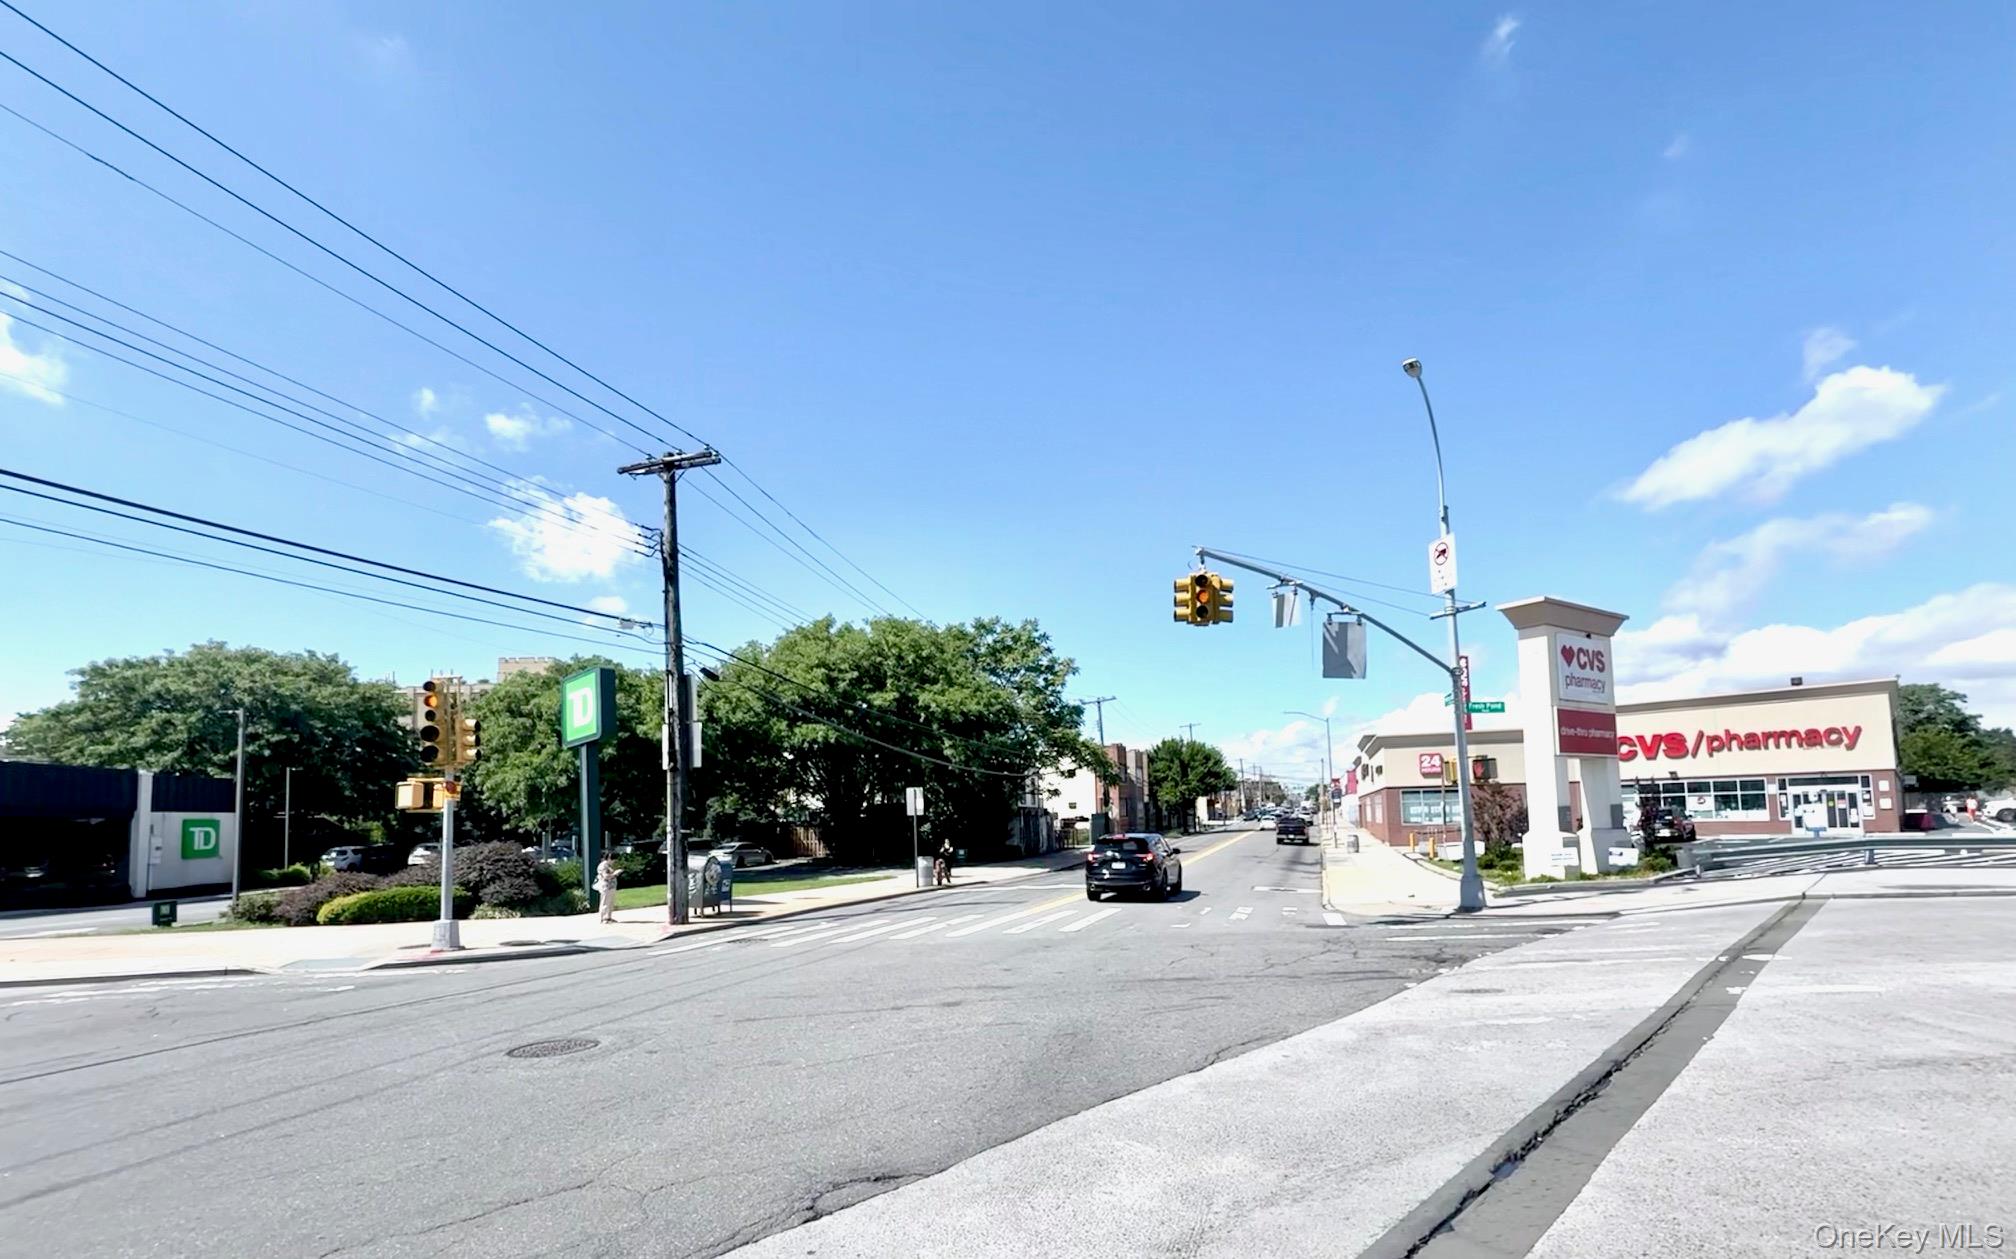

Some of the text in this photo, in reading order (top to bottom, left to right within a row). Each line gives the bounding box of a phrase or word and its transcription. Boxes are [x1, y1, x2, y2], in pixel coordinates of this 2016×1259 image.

[1577, 646, 1605, 673] CVS
[1565, 673, 1606, 694] pharmacy
[568, 687, 594, 729] TD
[1421, 754, 1441, 767] 24
[188, 826, 217, 851] TD
